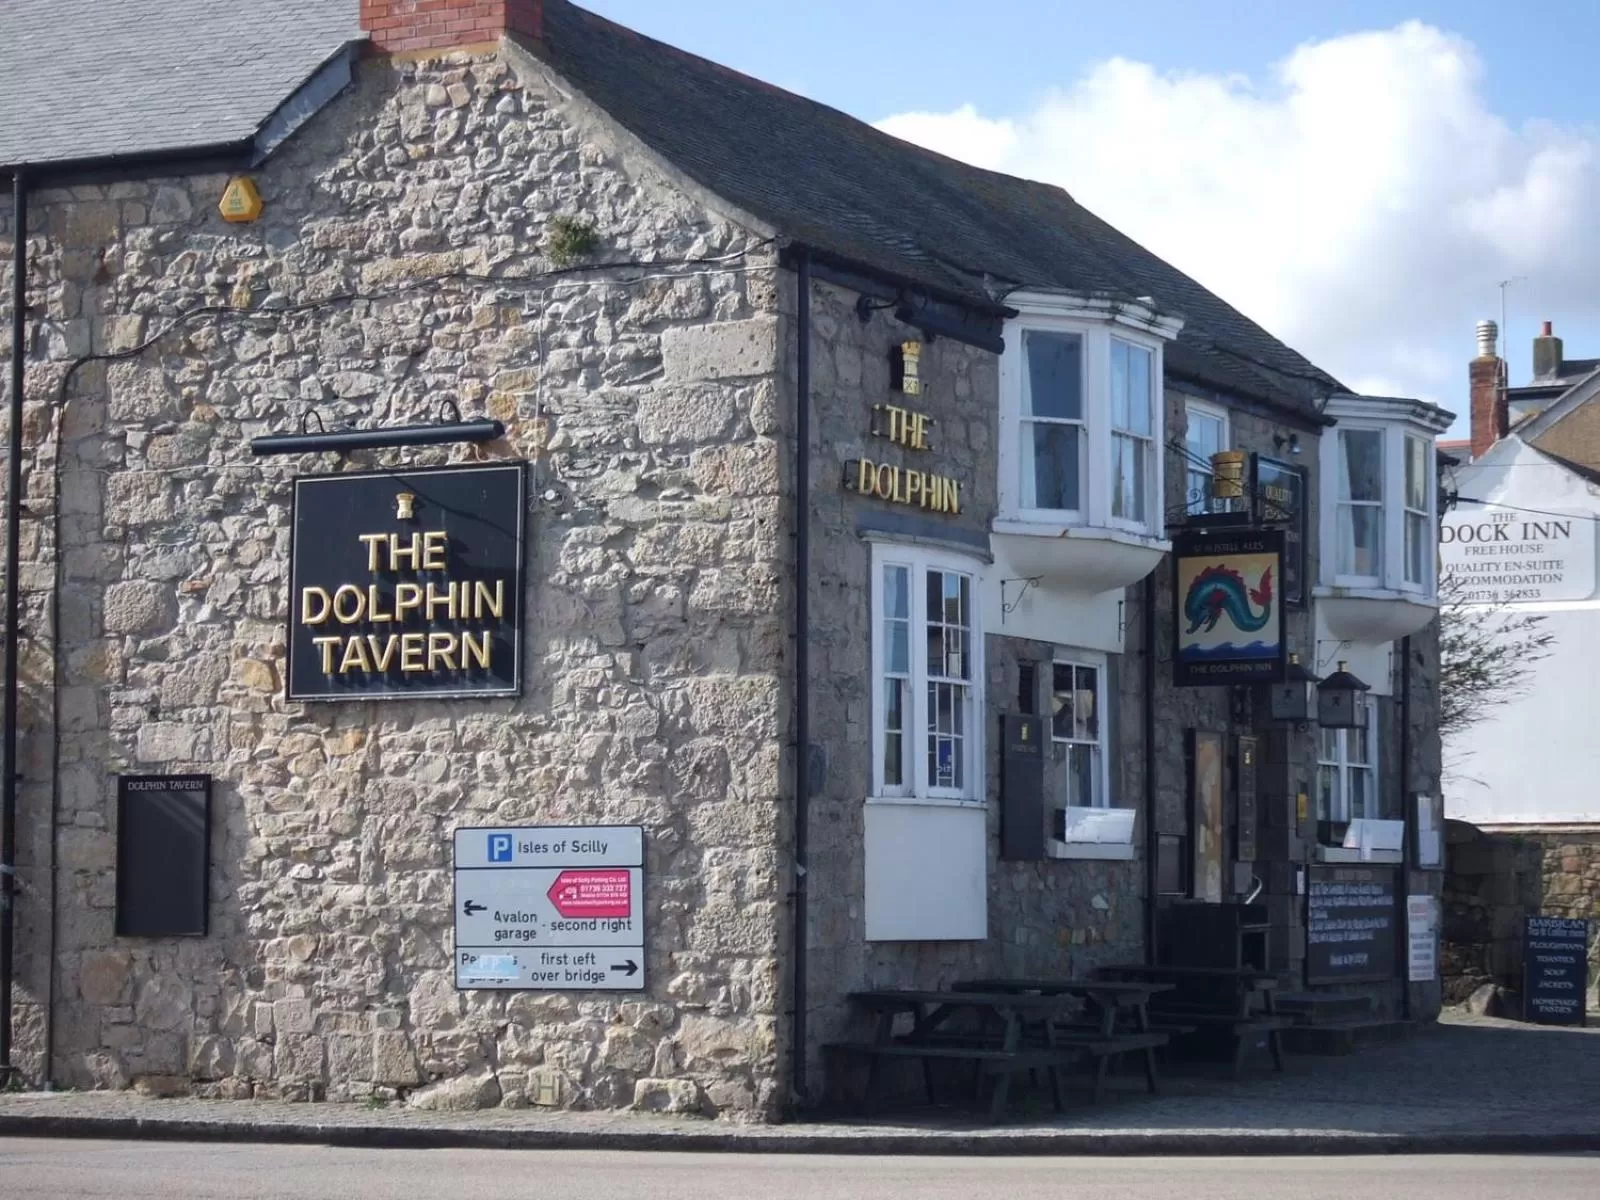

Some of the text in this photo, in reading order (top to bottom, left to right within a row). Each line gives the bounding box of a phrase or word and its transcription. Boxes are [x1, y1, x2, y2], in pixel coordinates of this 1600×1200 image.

[886, 404, 930, 449] THE
[859, 456, 959, 514] DOLPHIN
[1490, 512, 1517, 523] THE
[1440, 521, 1571, 543] DOCK INN
[358, 531, 447, 571] THE
[1464, 544, 1544, 556] FREE HOUSE
[1445, 559, 1564, 573] QUALITY EN-SUITE
[301, 580, 504, 624] DOLPHIN
[312, 630, 491, 674] TAVERN
[1209, 663, 1253, 673] DOLPHIN
[127, 780, 204, 791] DOLPHIN TAVERN
[518, 841, 549, 854] Isles
[553, 840, 567, 853] of
[571, 840, 608, 855] Scilly
[494, 911, 537, 923] Avalon
[551, 918, 632, 933] second right
[494, 928, 537, 941] garage
[541, 952, 596, 965] first left
[531, 969, 606, 984] over bridge
